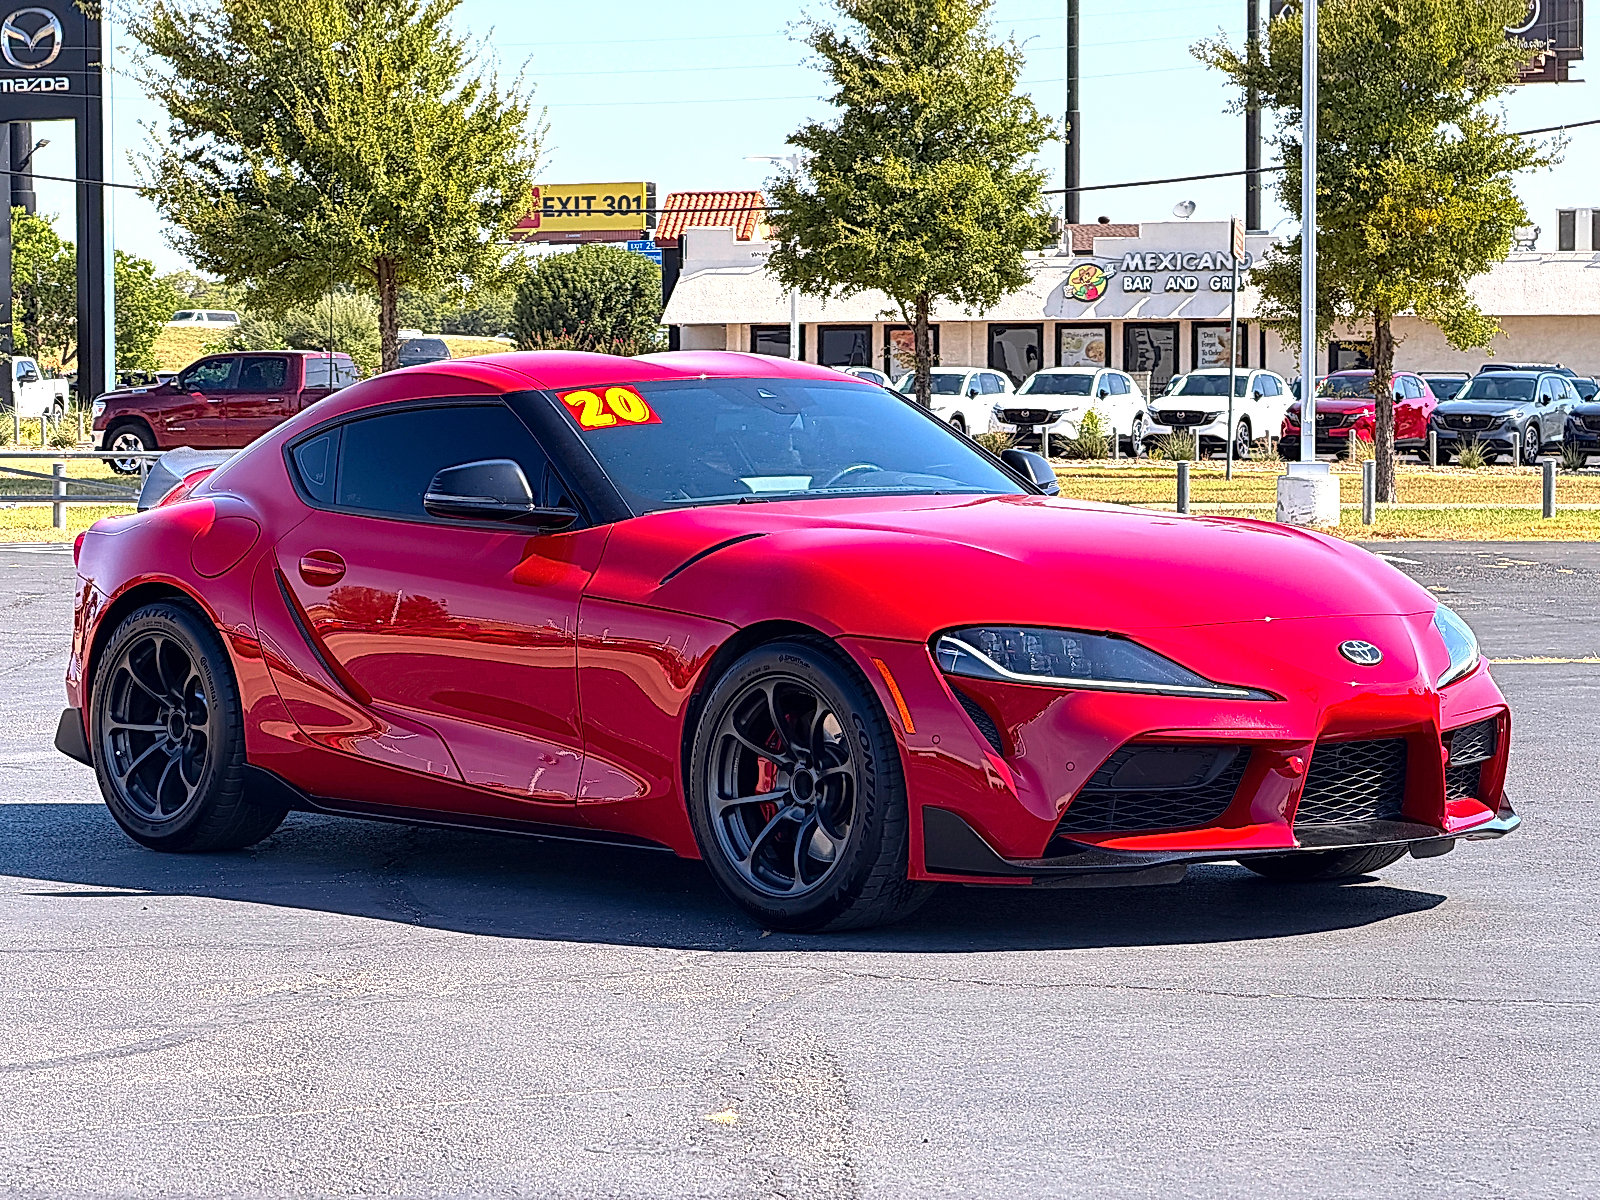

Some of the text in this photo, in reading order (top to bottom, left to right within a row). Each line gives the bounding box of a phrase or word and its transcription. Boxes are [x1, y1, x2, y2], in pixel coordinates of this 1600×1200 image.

[542, 195, 642, 218] EXIT 301
[1123, 275, 1152, 292] BAR
[1165, 275, 1198, 292] AND
[563, 387, 650, 427] 20
